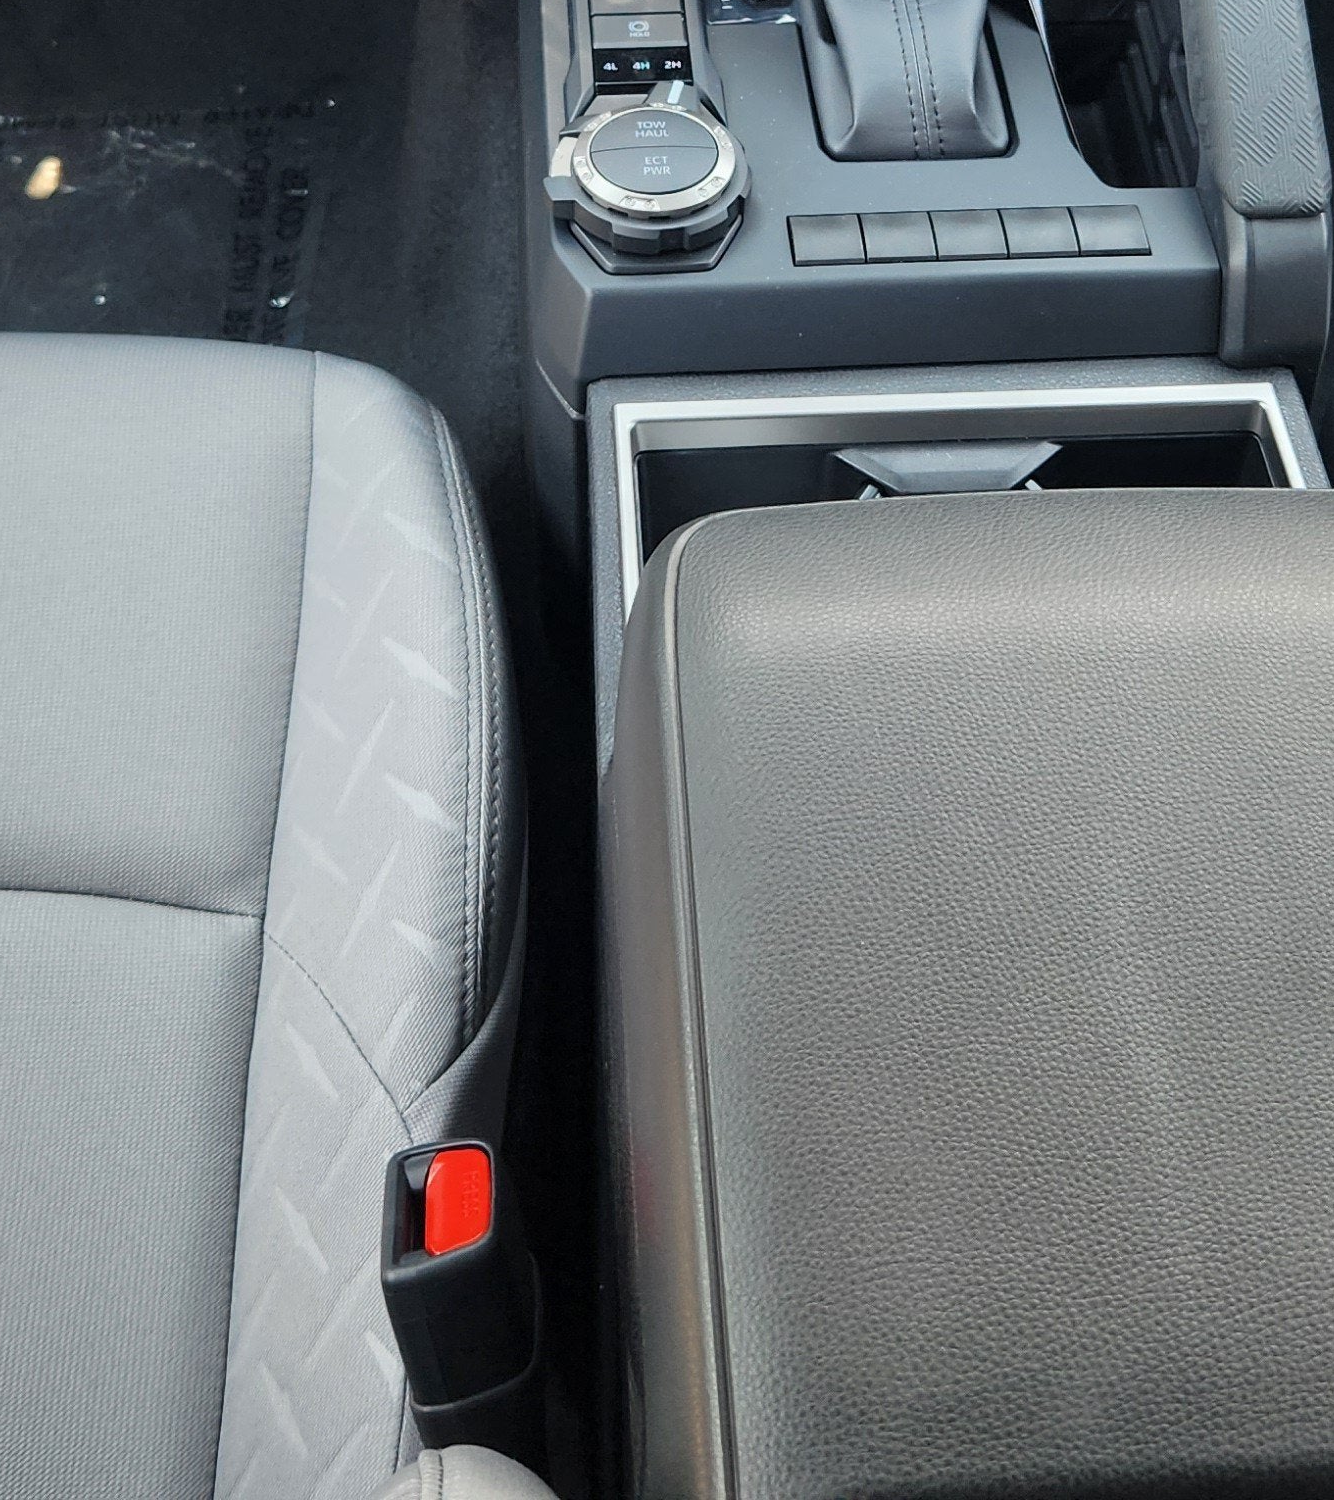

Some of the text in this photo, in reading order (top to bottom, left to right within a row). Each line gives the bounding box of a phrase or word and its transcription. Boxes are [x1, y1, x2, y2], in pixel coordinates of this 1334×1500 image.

[629, 30, 651, 38] HOLD
[603, 60, 682, 72] 4L 4H 2H
[636, 120, 667, 130] TOW
[634, 129, 669, 138] HAUL
[644, 155, 669, 166] ECT
[643, 166, 672, 176] PWR
